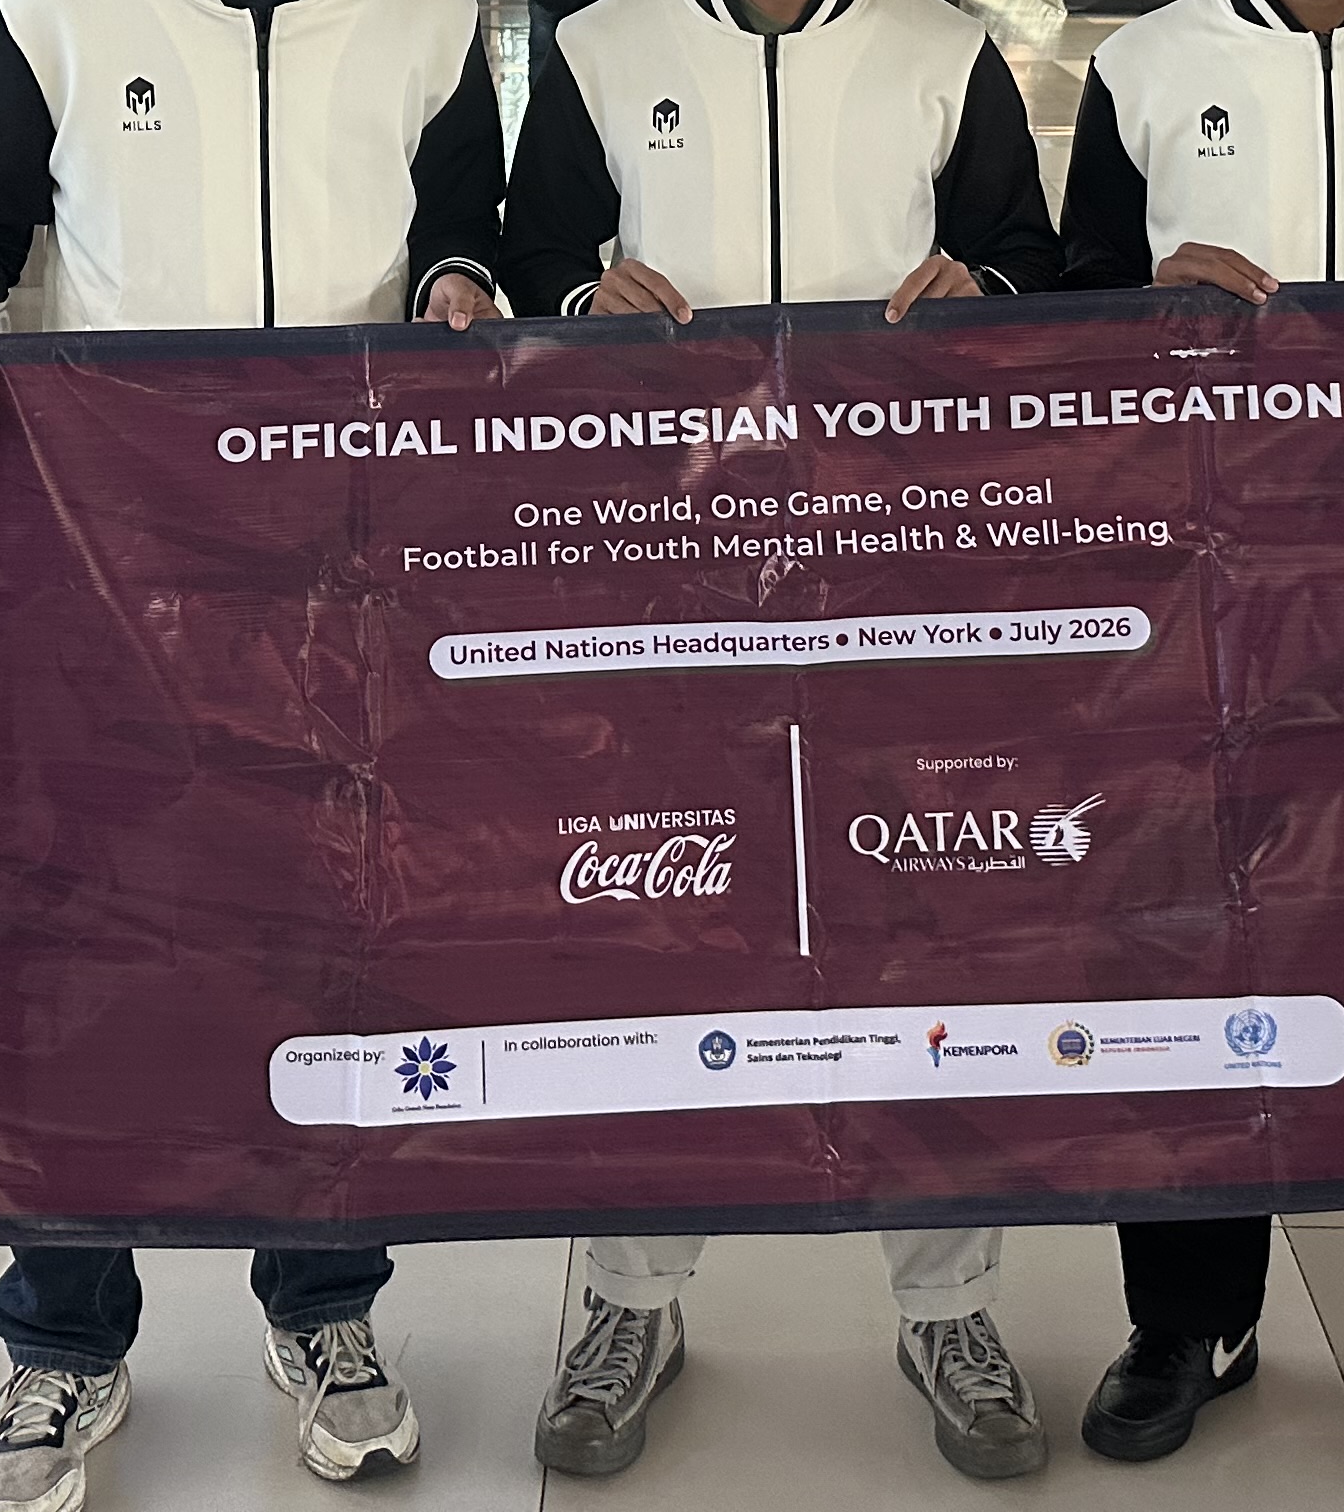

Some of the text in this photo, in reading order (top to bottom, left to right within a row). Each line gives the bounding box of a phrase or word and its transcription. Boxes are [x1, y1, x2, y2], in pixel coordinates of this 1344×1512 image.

[122, 120, 162, 132] MILLS
[648, 137, 685, 151] MILLS
[1197, 144, 1235, 159] MILLS
[217, 381, 1344, 464] OFFICIAL INDONESIAN YOUTH DELEGATION
[513, 477, 1054, 529] One World, One Game, One Goal
[402, 514, 1169, 572] Football for Youth Mental Health & Well-being
[449, 614, 1133, 667] United Nations Headquarters New York July 2026
[916, 754, 1020, 774] Supported by:
[558, 807, 737, 835] LIGA UNIVERSITAS
[848, 808, 1024, 864] QATAR
[559, 833, 737, 905] Coca-Cola
[891, 855, 966, 873] AIRWAYS
[966, 855, 1026, 873] القطرية
[504, 1029, 658, 1053] In collaboration with:
[745, 1032, 902, 1049] Kementerian Pendidikan Tinggi,
[1099, 1034, 1201, 1045] KEMENTERIAN LUAR NEGERI
[284, 1047, 386, 1066] Organized by:
[746, 1048, 843, 1064] Sains dan Teknologi
[942, 1043, 1019, 1059] KEMENPORA
